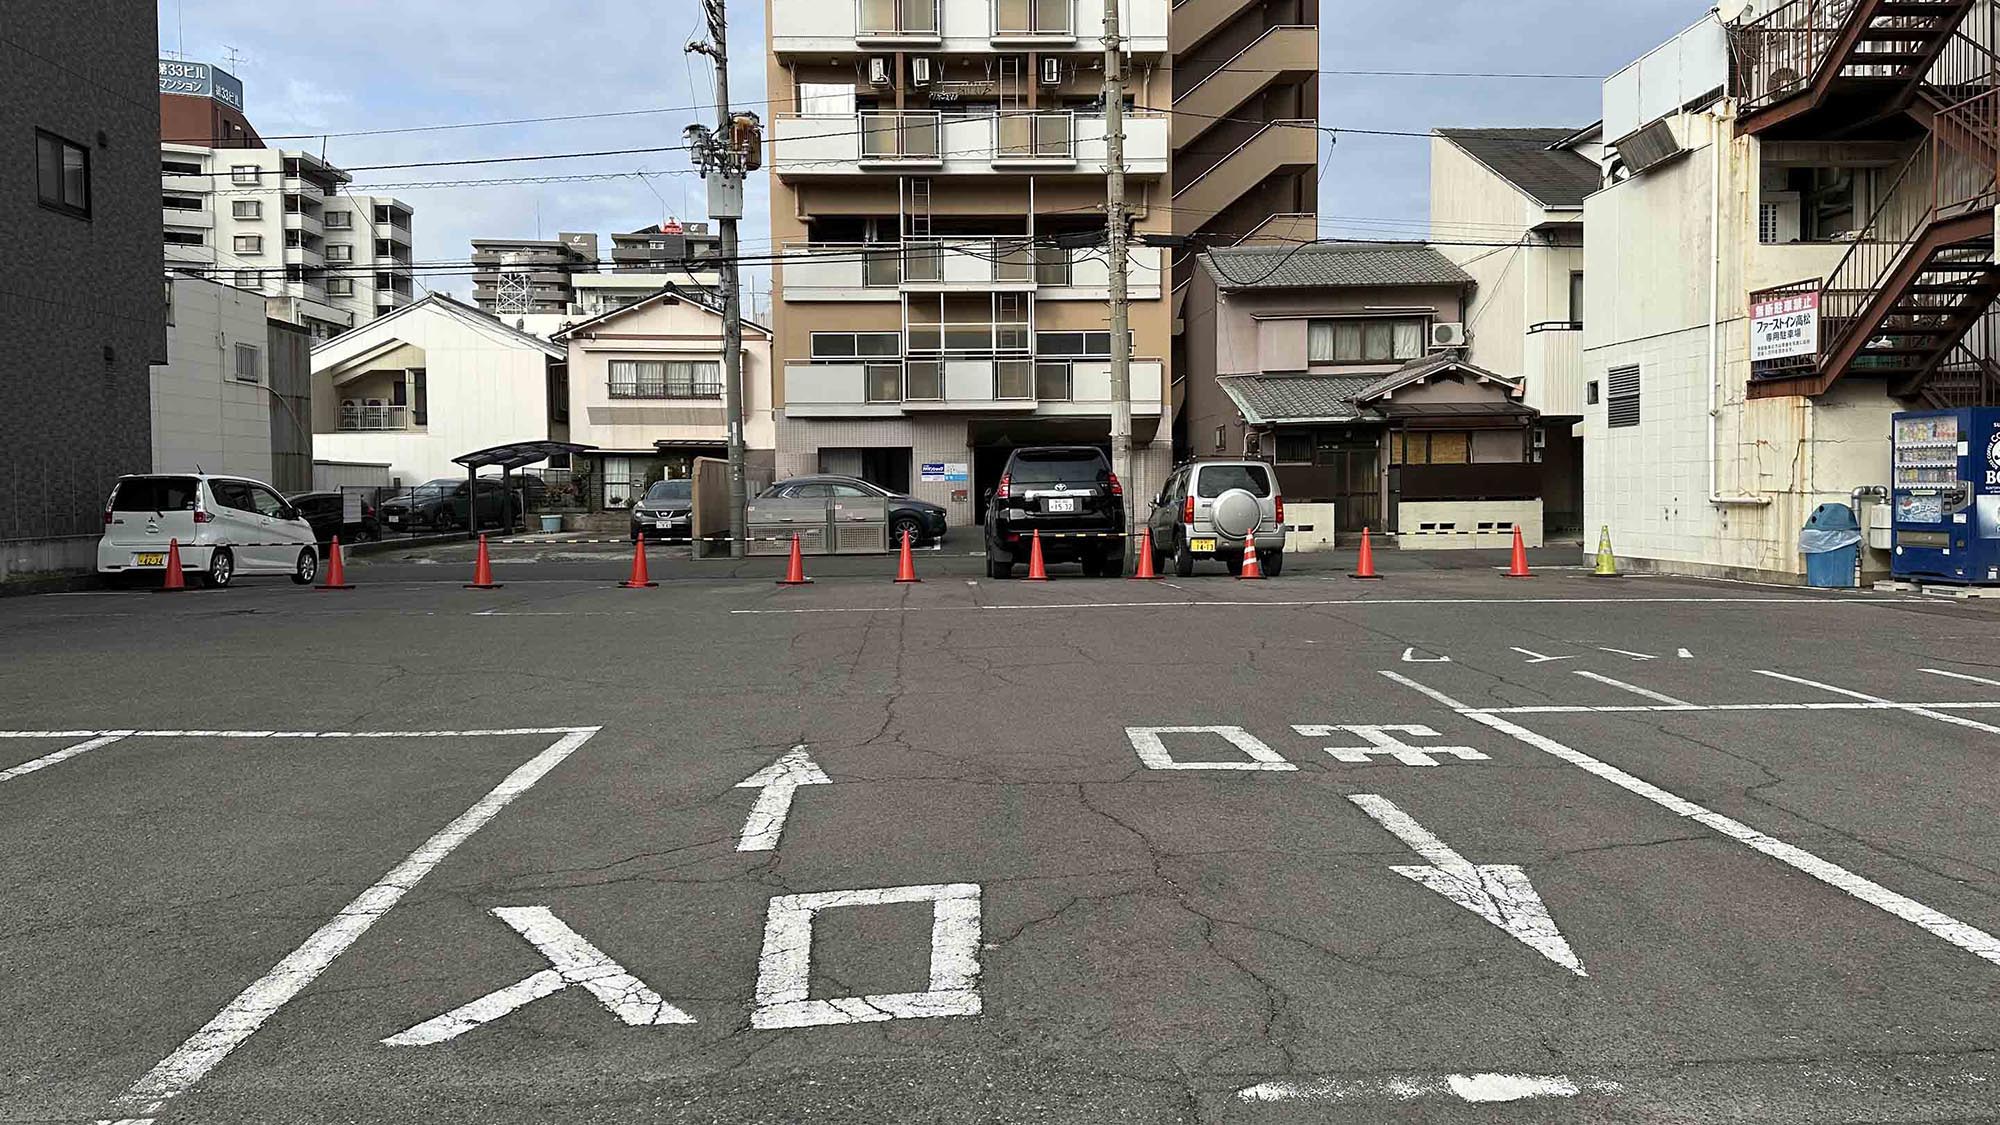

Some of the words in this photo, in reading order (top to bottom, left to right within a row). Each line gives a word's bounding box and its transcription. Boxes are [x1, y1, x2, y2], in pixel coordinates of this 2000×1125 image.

[1756, 313, 1811, 333] ファーストイン高松
[1125, 724, 1493, 771] 出口
[379, 883, 983, 1046] 入口
